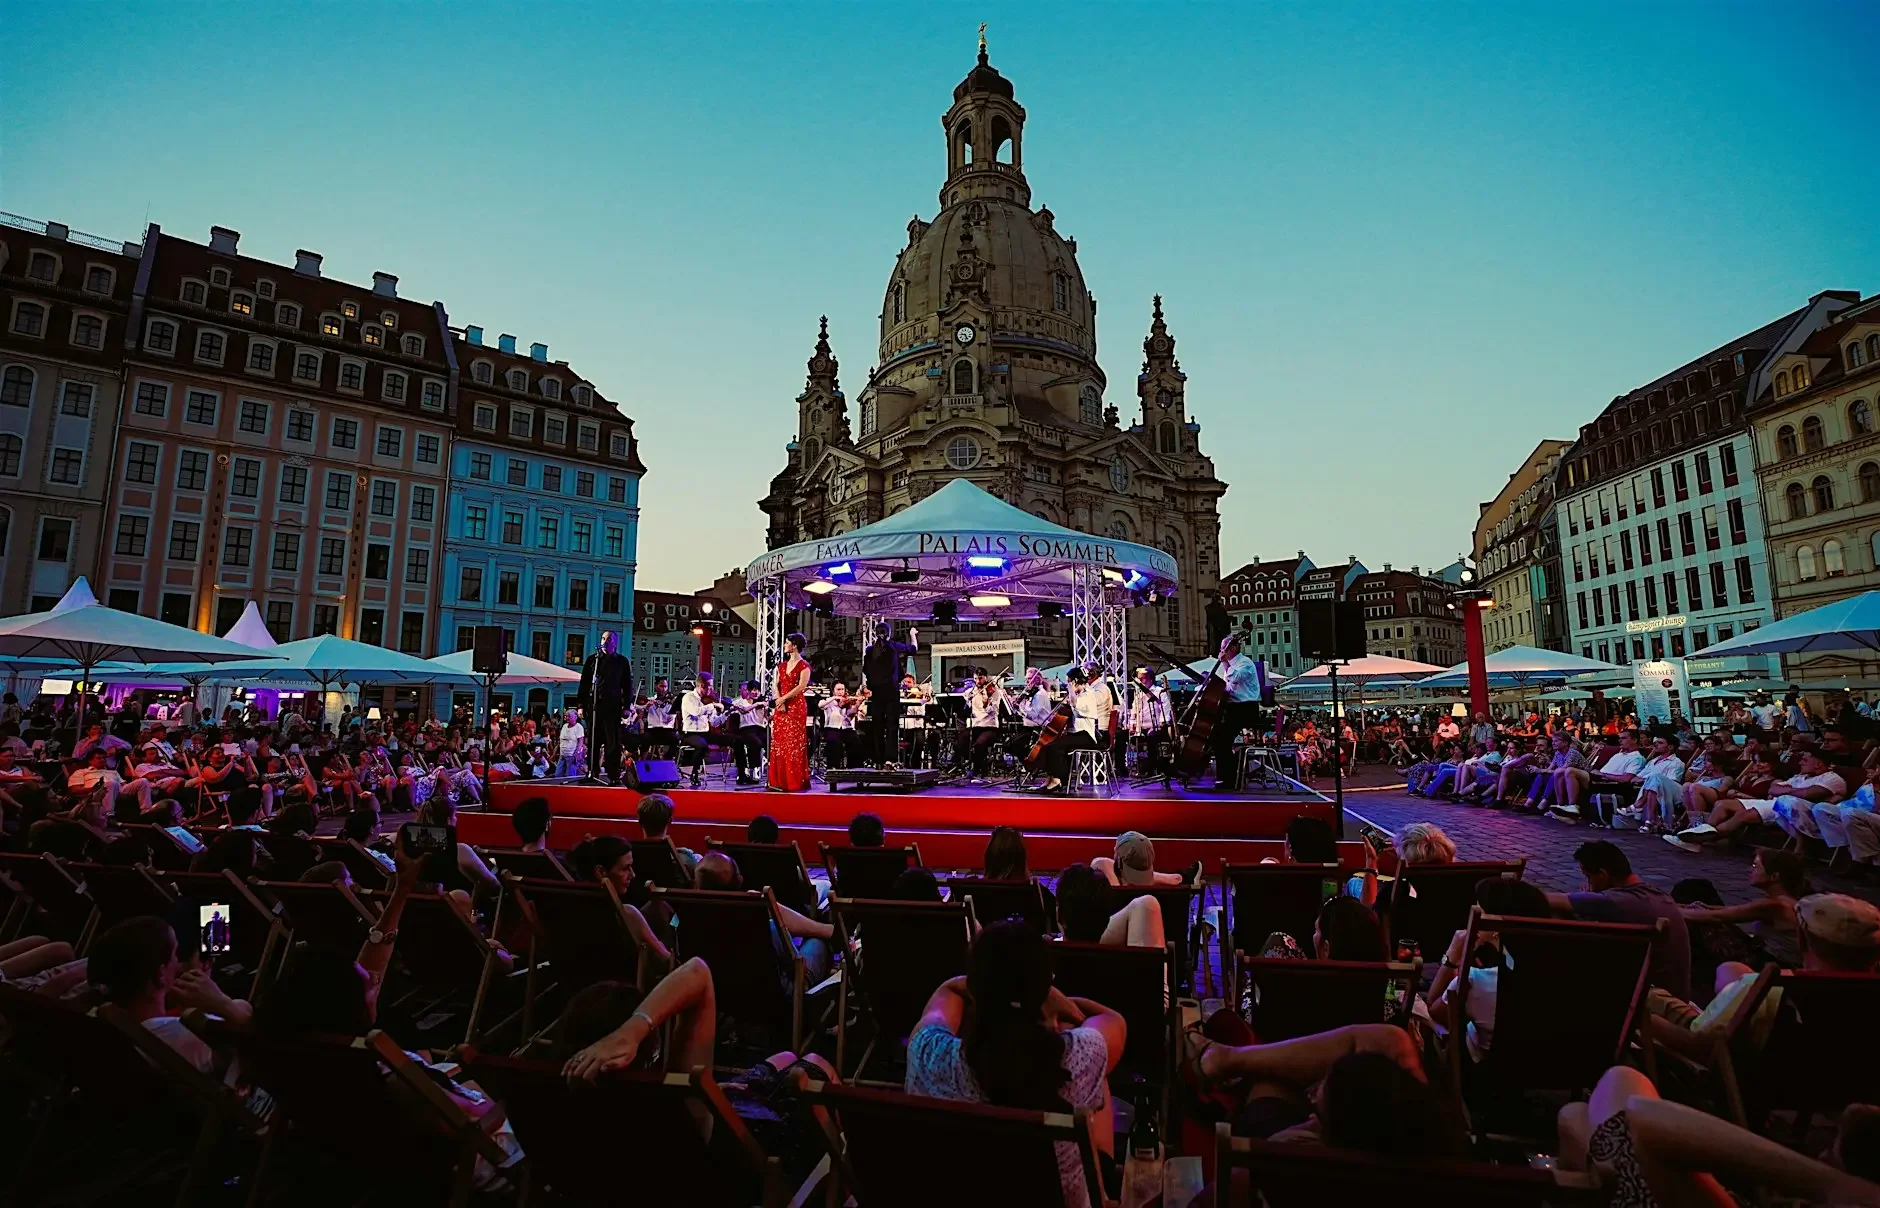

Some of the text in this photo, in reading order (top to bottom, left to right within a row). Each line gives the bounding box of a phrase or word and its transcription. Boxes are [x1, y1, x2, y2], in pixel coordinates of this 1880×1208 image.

[816, 541, 861, 560] FAMA
[919, 532, 1118, 565] PALAIS SOMMER
[1662, 615, 1686, 627] Lounge
[955, 645, 977, 653] PALAIS
[977, 643, 1007, 652] SOMMER
[1639, 669, 1676, 677] SOMMER
